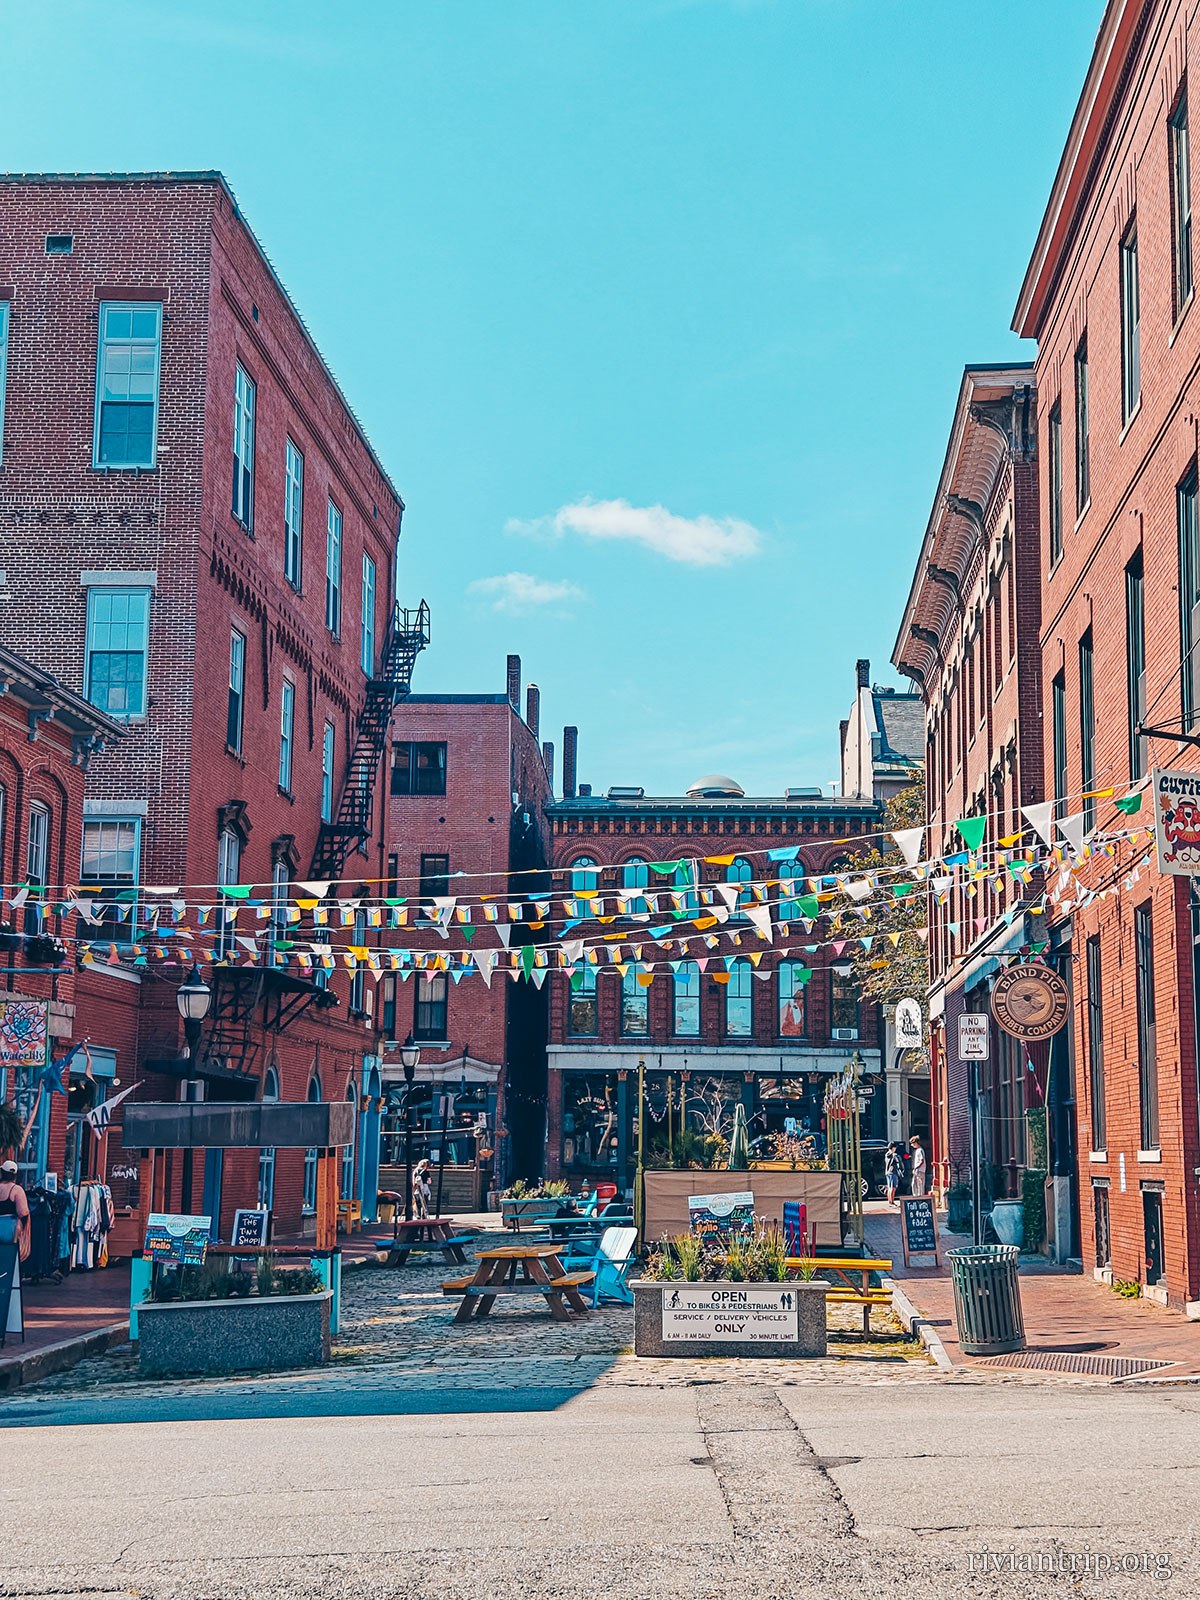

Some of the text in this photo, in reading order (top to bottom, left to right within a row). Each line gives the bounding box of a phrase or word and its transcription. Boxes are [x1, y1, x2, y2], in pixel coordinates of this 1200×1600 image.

[1001, 968, 1061, 991] BLIND PIG
[967, 1017, 979, 1026] NO
[997, 1005, 1065, 1036] BARBER COMPANY
[961, 1027, 986, 1036] PARKING
[577, 1096, 591, 1105] LAZY
[242, 1218, 258, 1226] THE
[911, 1218, 928, 1227] fade
[150, 1240, 171, 1250] Hello
[711, 1291, 747, 1302] OPEN
[699, 1302, 720, 1310] BIKES
[728, 1302, 778, 1310] PEDESTRIANS
[714, 1323, 746, 1333] ONLY
